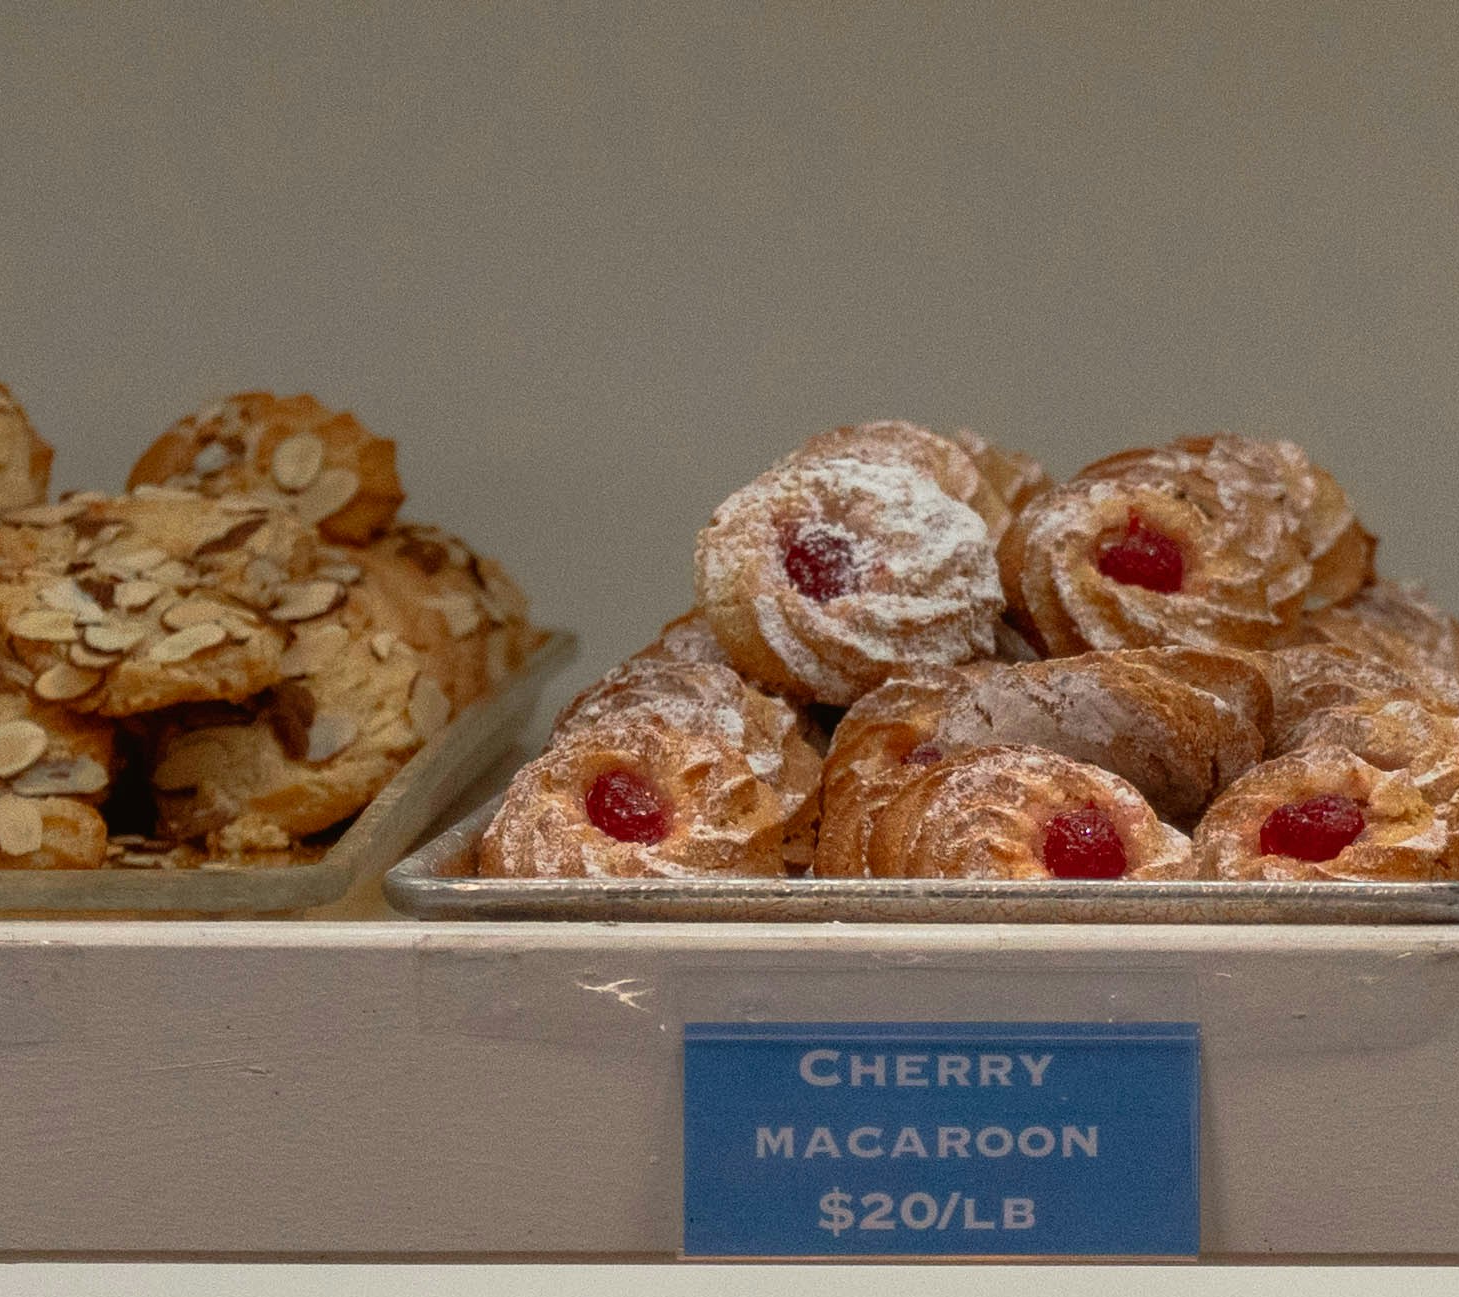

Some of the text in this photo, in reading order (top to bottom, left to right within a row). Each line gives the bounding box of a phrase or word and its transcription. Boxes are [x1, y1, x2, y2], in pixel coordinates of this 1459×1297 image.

[798, 1049, 1052, 1087] CHERRY
[755, 1125, 1098, 1159] MACAROON
[818, 1187, 1036, 1237] $20/LB
